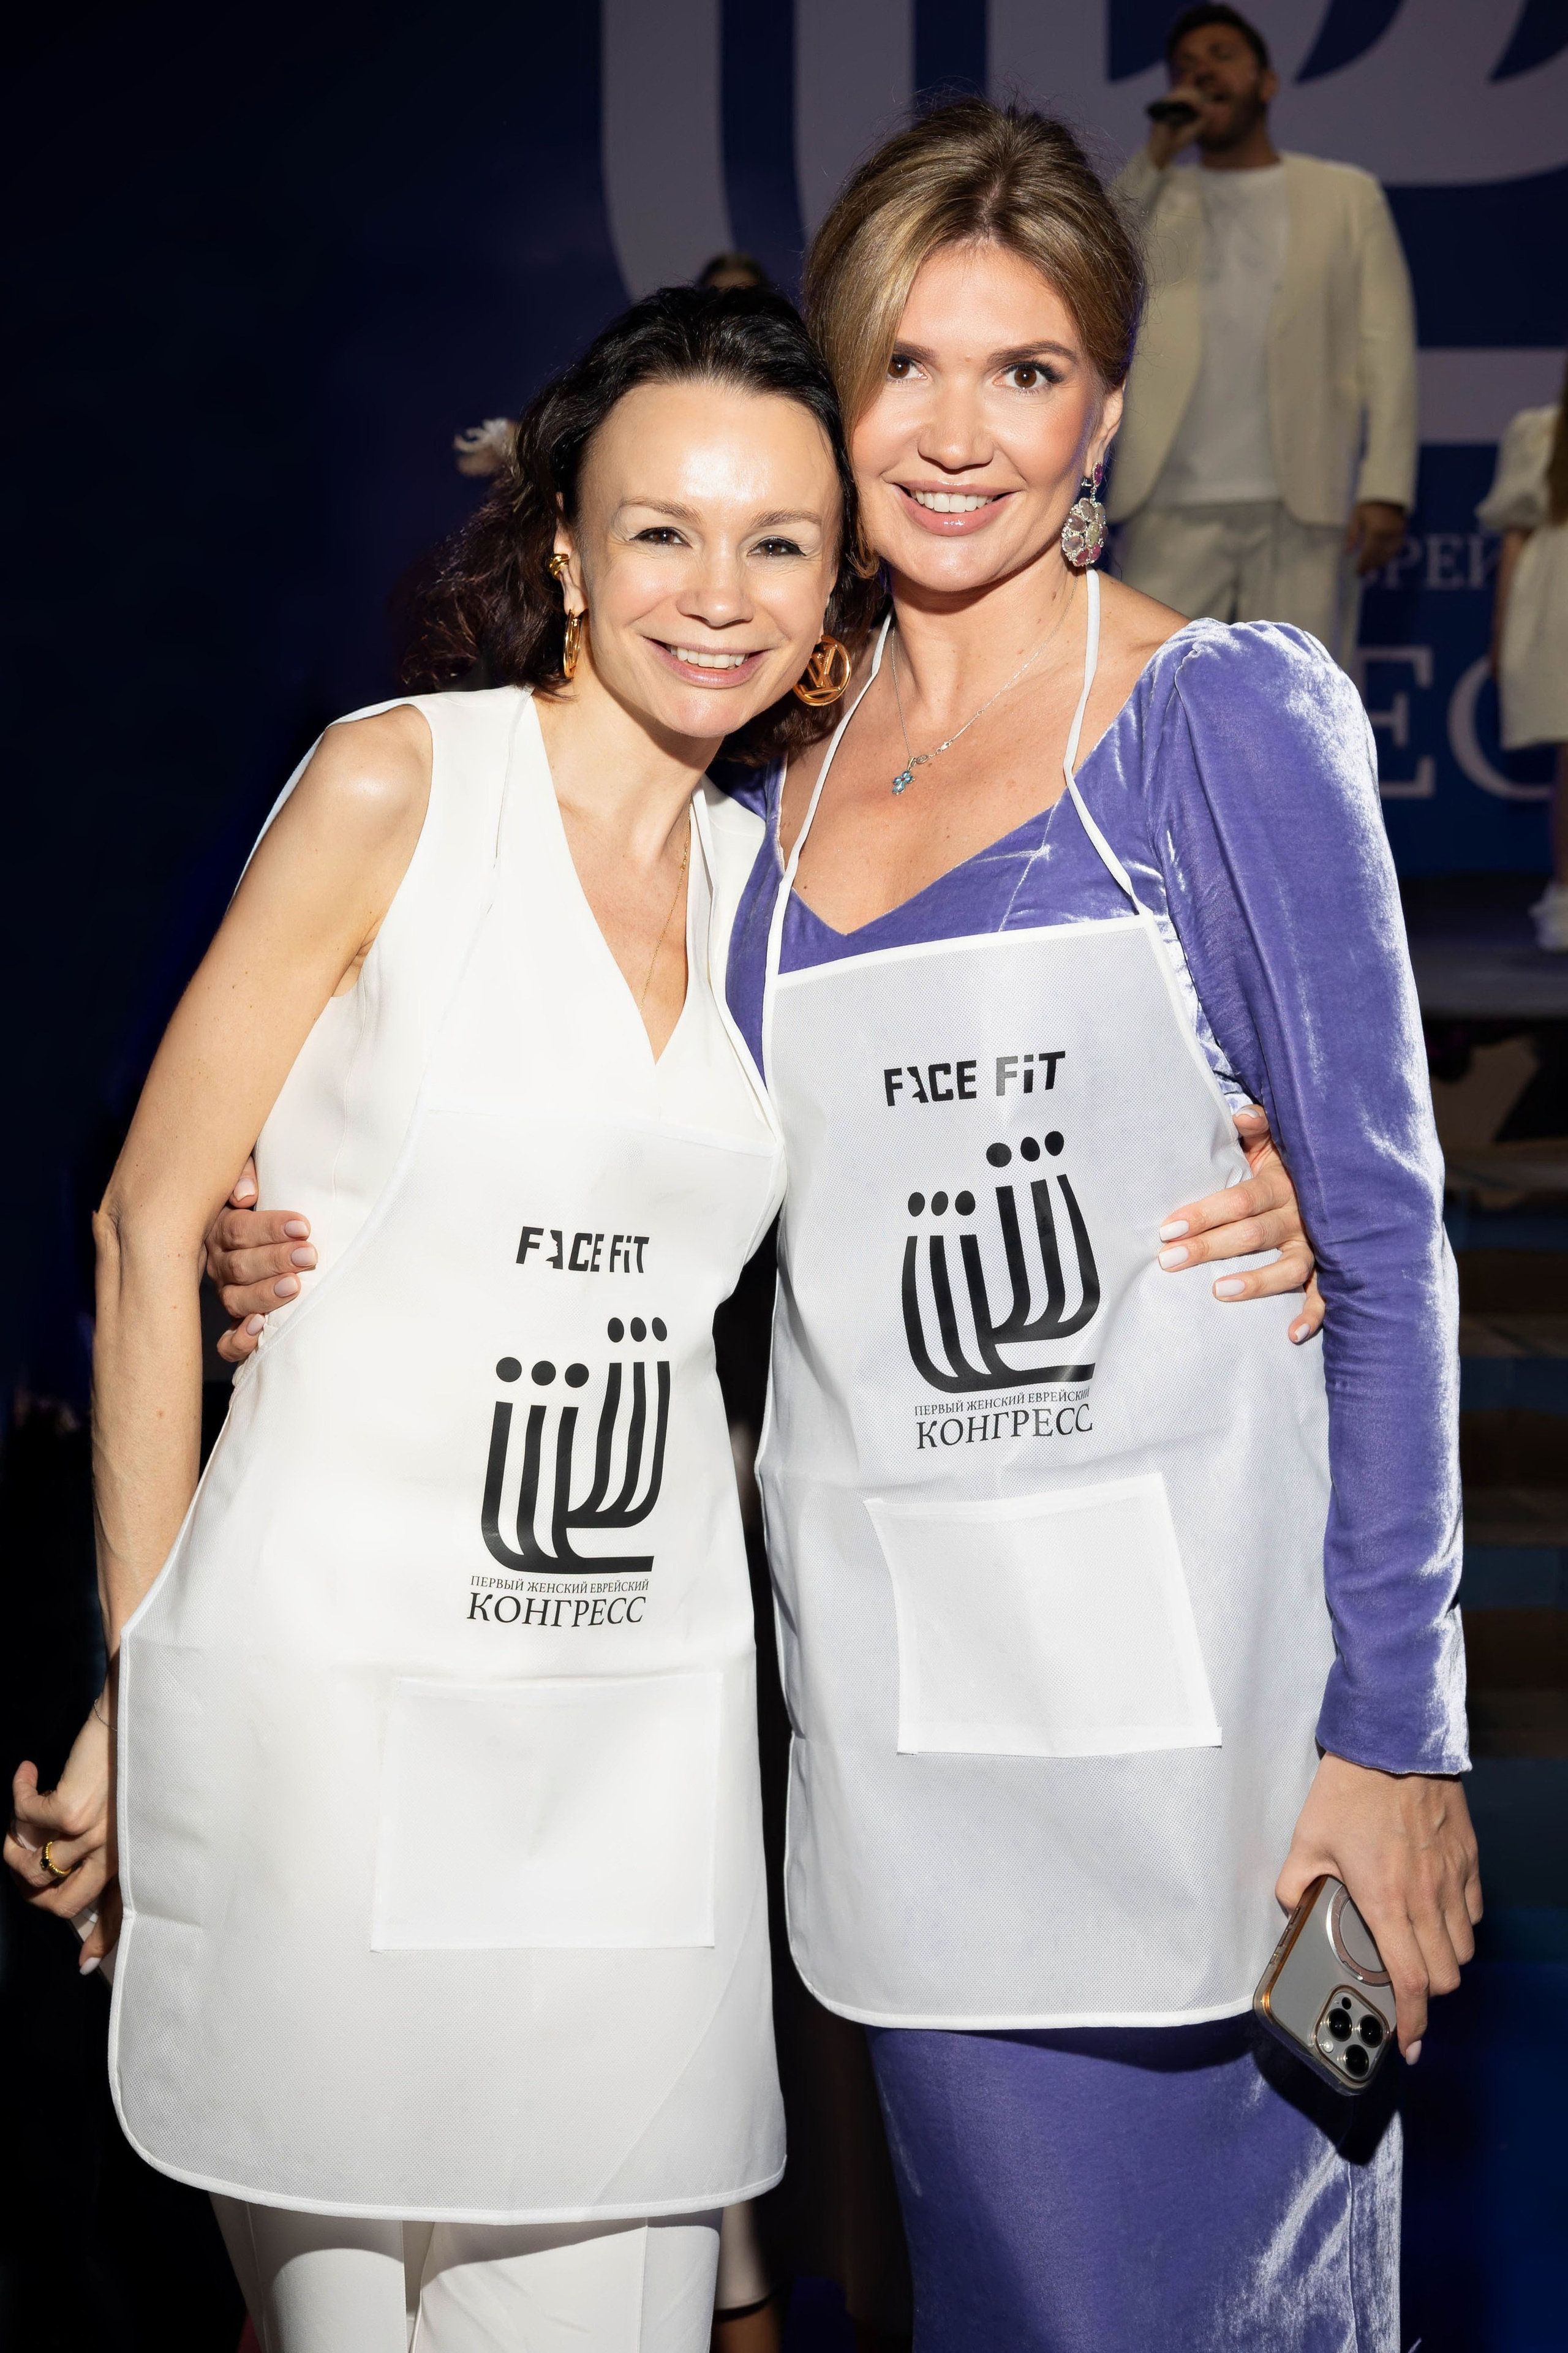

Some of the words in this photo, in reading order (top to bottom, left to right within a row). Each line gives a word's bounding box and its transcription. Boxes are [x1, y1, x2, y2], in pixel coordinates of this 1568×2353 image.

[914, 1400, 963, 1416] ПЕРВЫЙ
[967, 1392, 1025, 1411] ЖЕНСКИЙ
[916, 1403, 1093, 1449] КОНГРЕСС
[470, 1575, 524, 1591] ПЕРВЫЙ
[527, 1581, 588, 1593] ЖЕНСКИЙ
[590, 1579, 649, 1593] ЕВРЕЙСКИЙ
[466, 1592, 646, 1628] КОНГРЕСС
